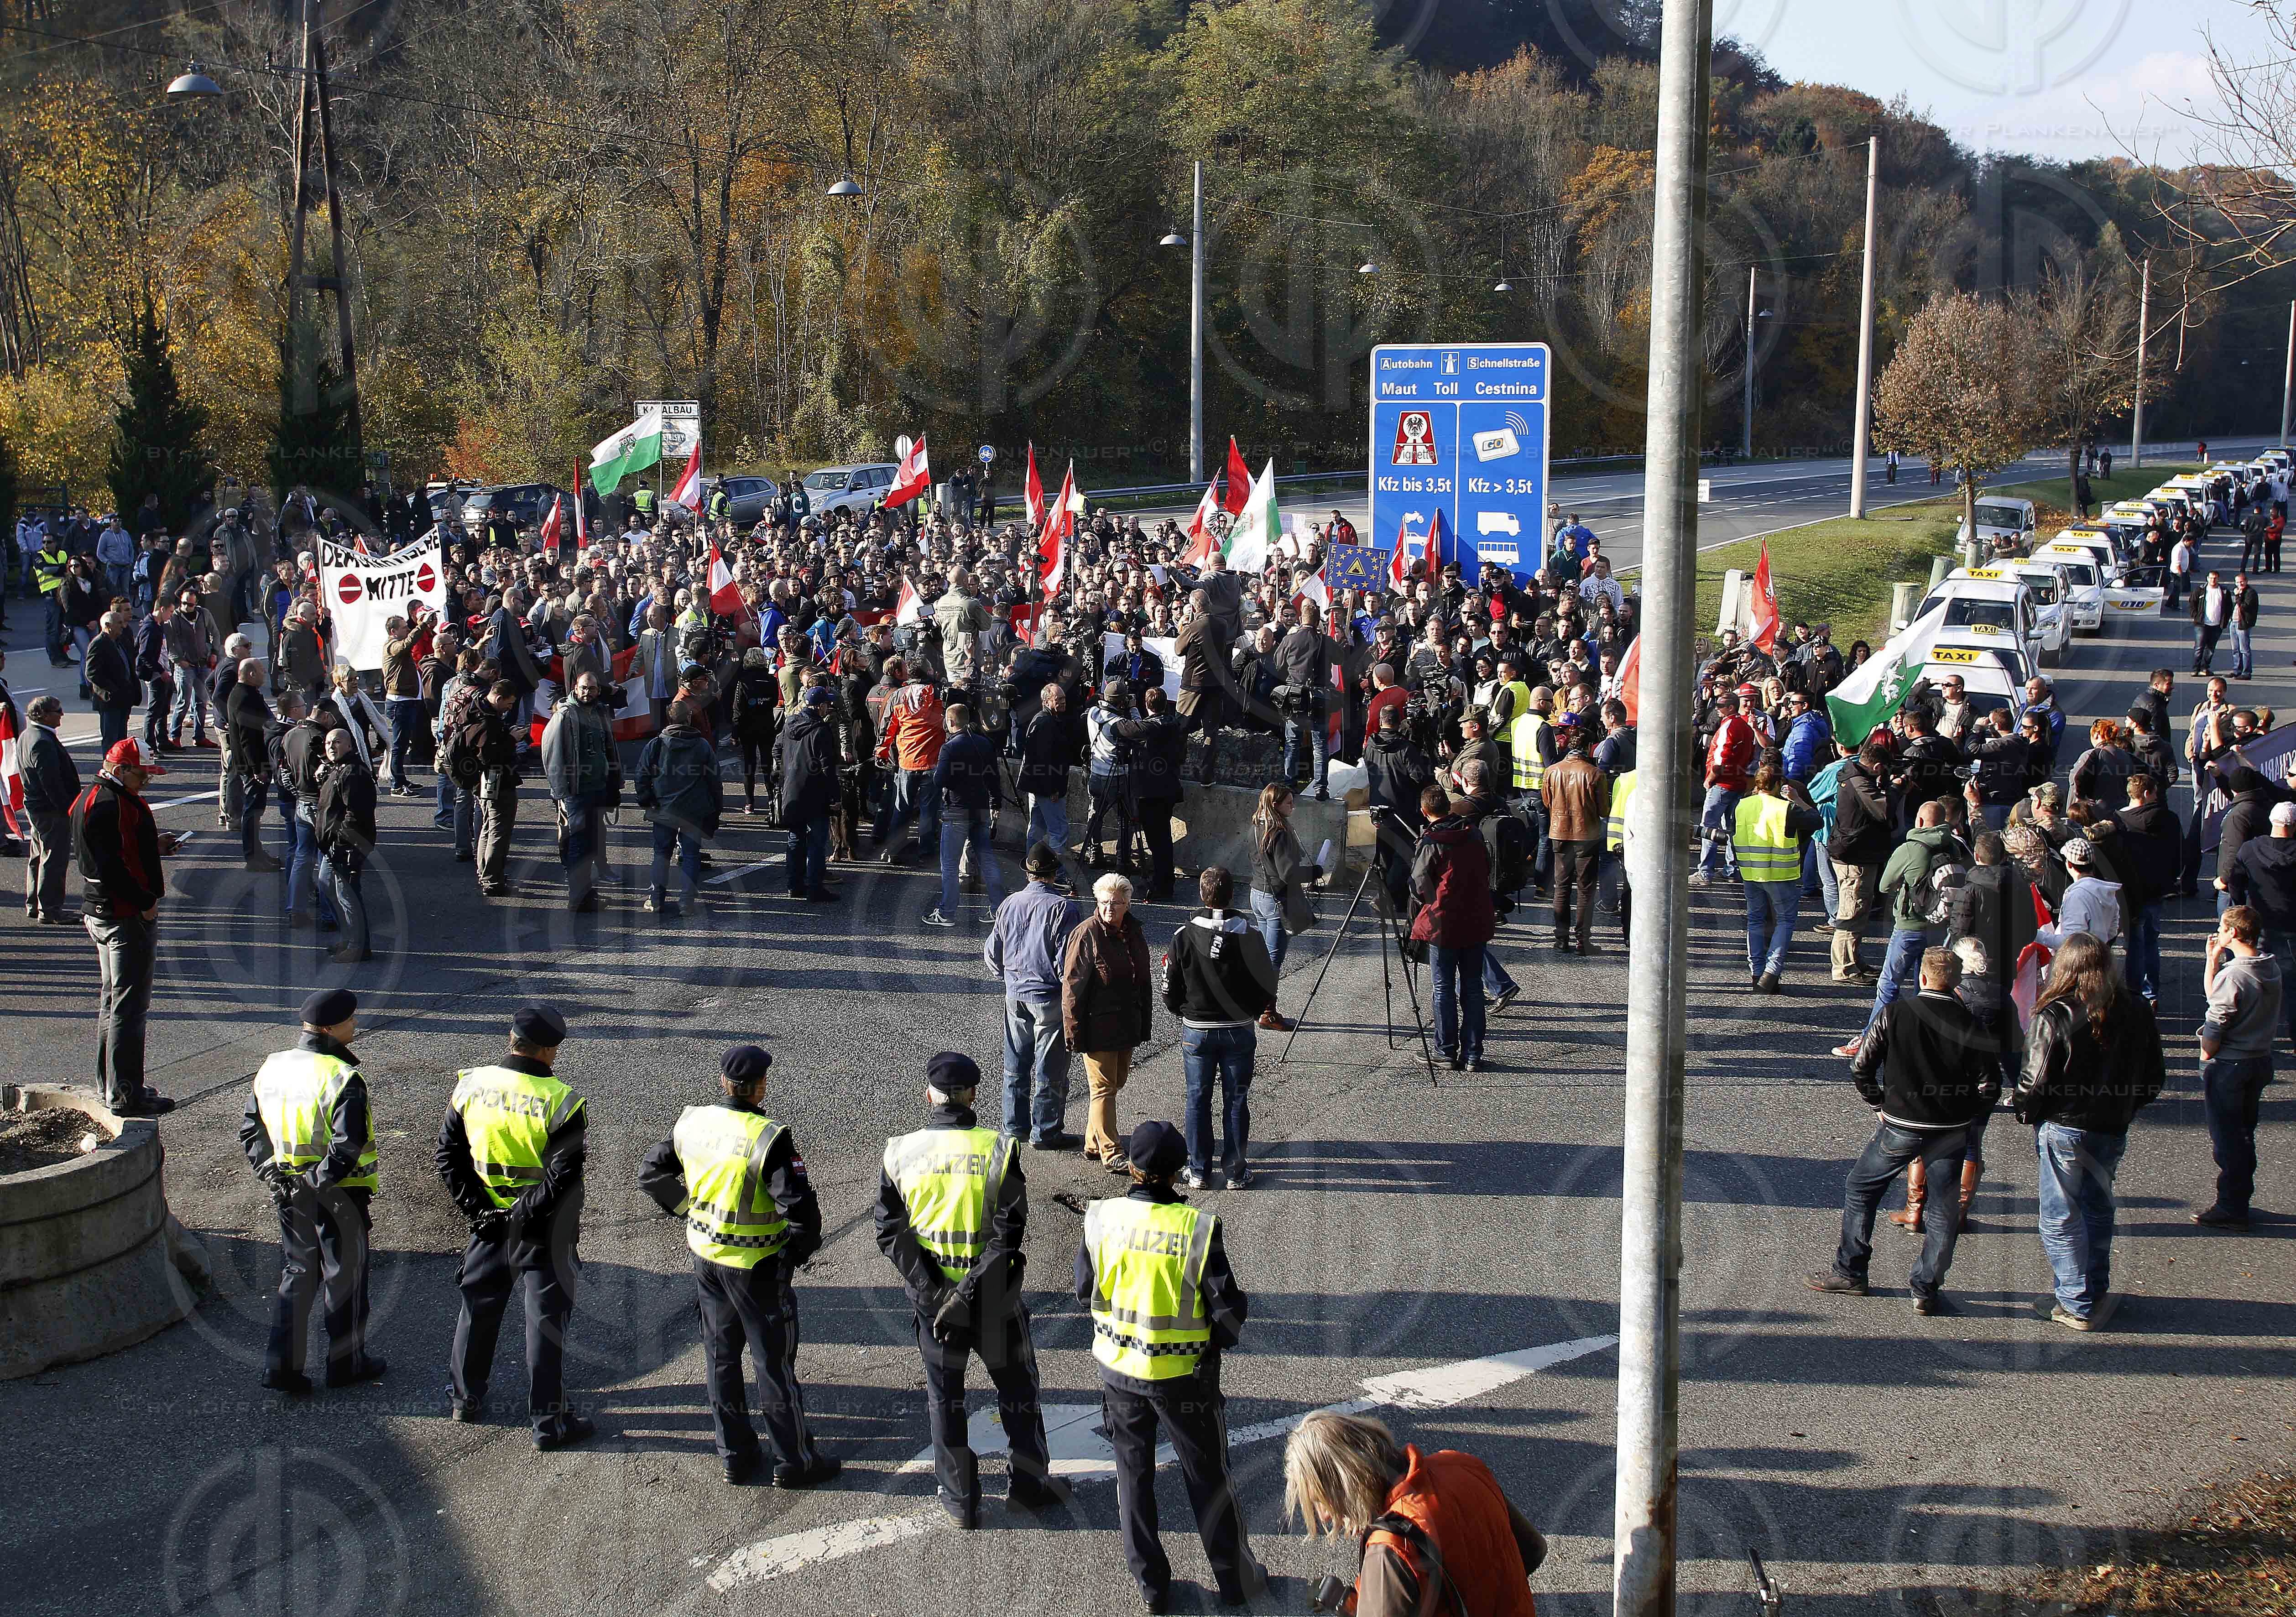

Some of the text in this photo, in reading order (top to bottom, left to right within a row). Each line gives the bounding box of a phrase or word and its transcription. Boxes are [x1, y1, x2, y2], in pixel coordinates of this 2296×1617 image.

[1381, 358, 1433, 370] Autobahn
[1468, 357, 1540, 370] Schnellstraße
[1382, 381, 1537, 395] Maut Toll Cestnina
[1485, 438, 1503, 450] GO
[1396, 448, 1435, 462] Vignette
[1378, 477, 1451, 494] Kfz bis 3,5t
[1468, 478, 1489, 493] Kfz
[1506, 480, 1533, 494] 3,5t
[366, 570, 415, 600] MITTE
[1592, 580, 1614, 589] CROSS
[1974, 625, 1995, 634] TAXI
[1933, 652, 1972, 661] TAXI
[471, 1087, 551, 1119] POLIZEI
